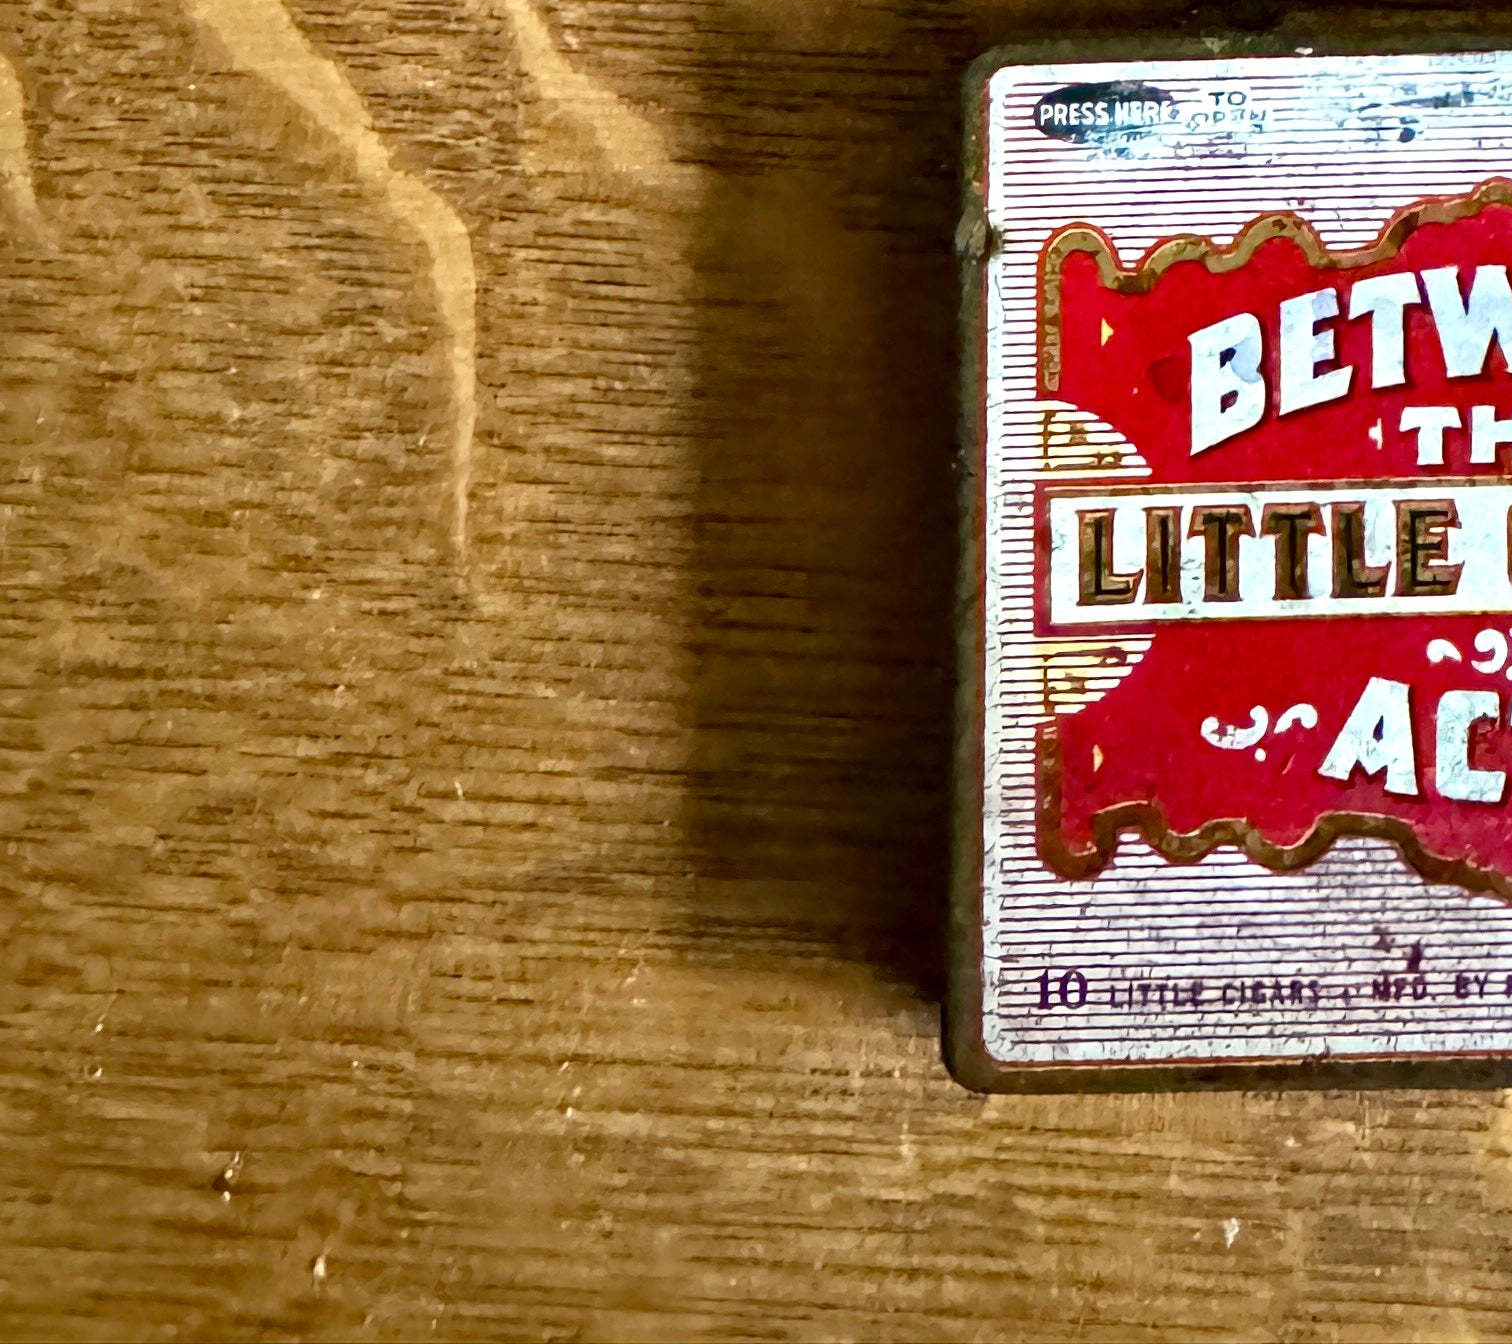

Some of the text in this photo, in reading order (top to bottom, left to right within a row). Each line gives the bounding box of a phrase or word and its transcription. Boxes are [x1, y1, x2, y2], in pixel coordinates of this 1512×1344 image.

[1039, 101, 1109, 127] PRESS
[1207, 91, 1248, 107] TO
[1074, 499, 1464, 607] LITTLE
[1035, 967, 1089, 1010] 10
[1109, 981, 1203, 1007] LITTLE
[1221, 979, 1321, 1005] CIGARS
[1455, 973, 1489, 999] BY
